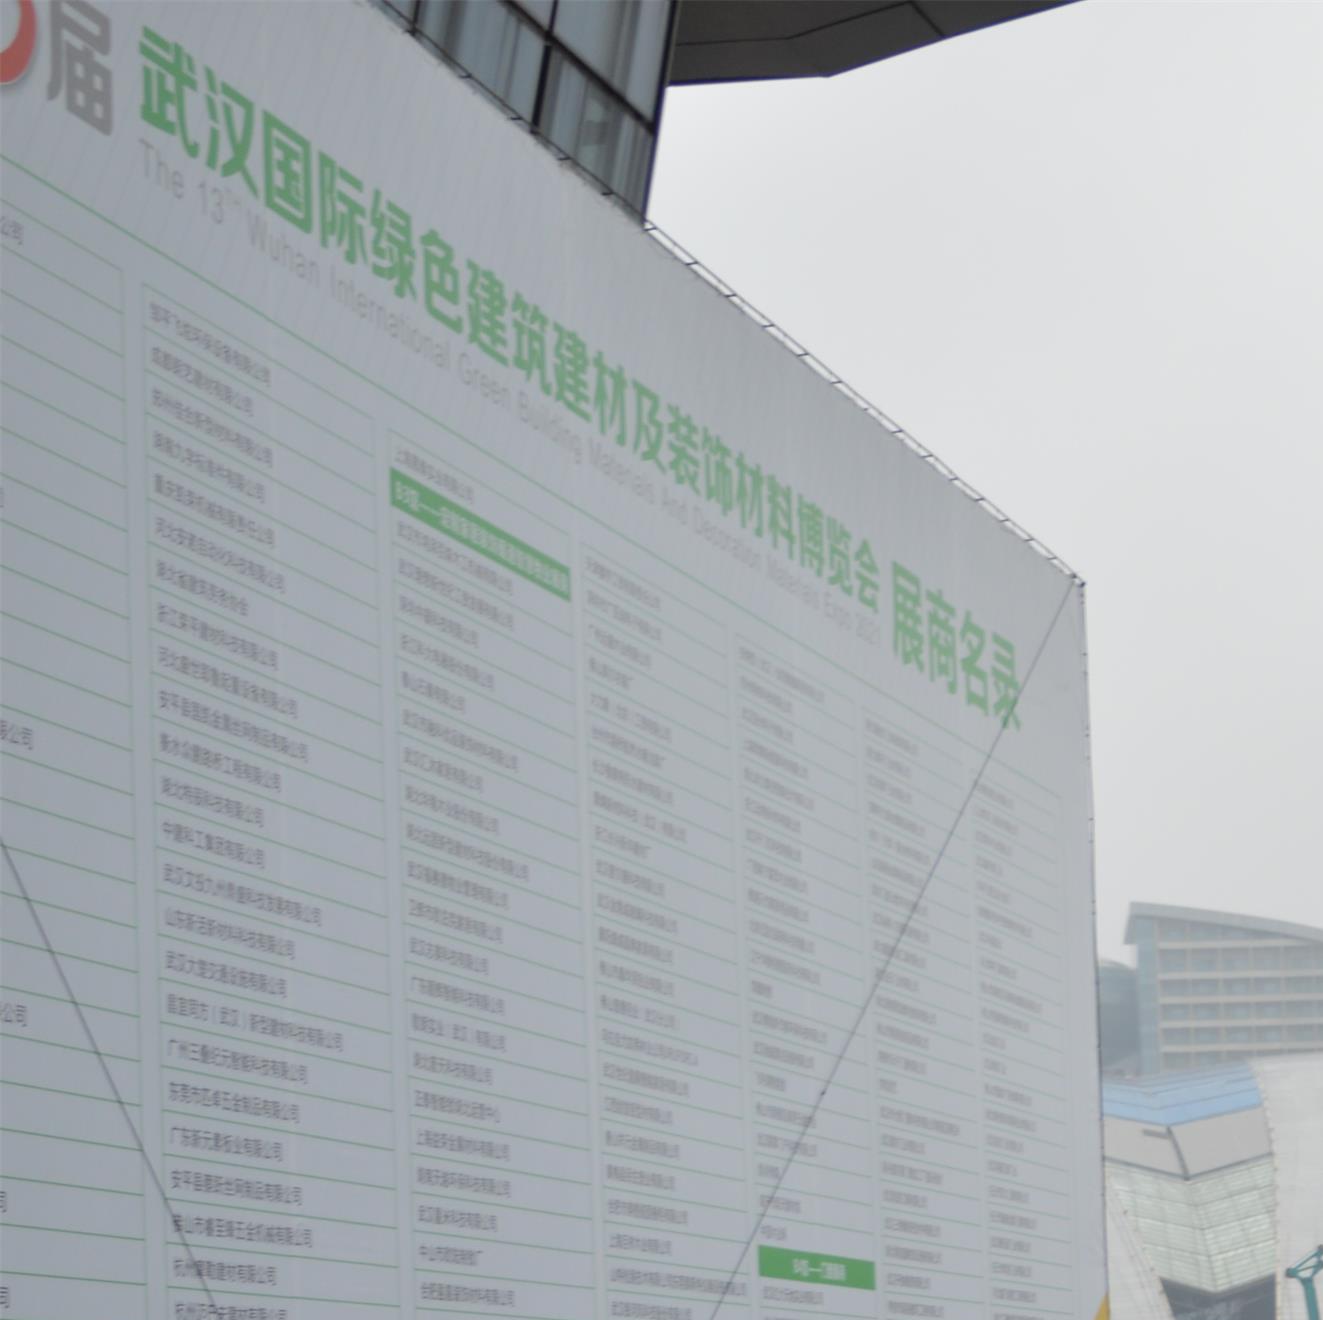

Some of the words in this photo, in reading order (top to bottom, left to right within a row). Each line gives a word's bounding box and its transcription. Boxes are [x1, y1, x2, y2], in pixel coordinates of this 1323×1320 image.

[137, 25, 880, 614] 武汉国际绿色建筑建材及装饰材料博览会
[247, 207, 321, 286] Wuhan
[330, 266, 450, 371] International
[891, 561, 1022, 730] 展商名录
